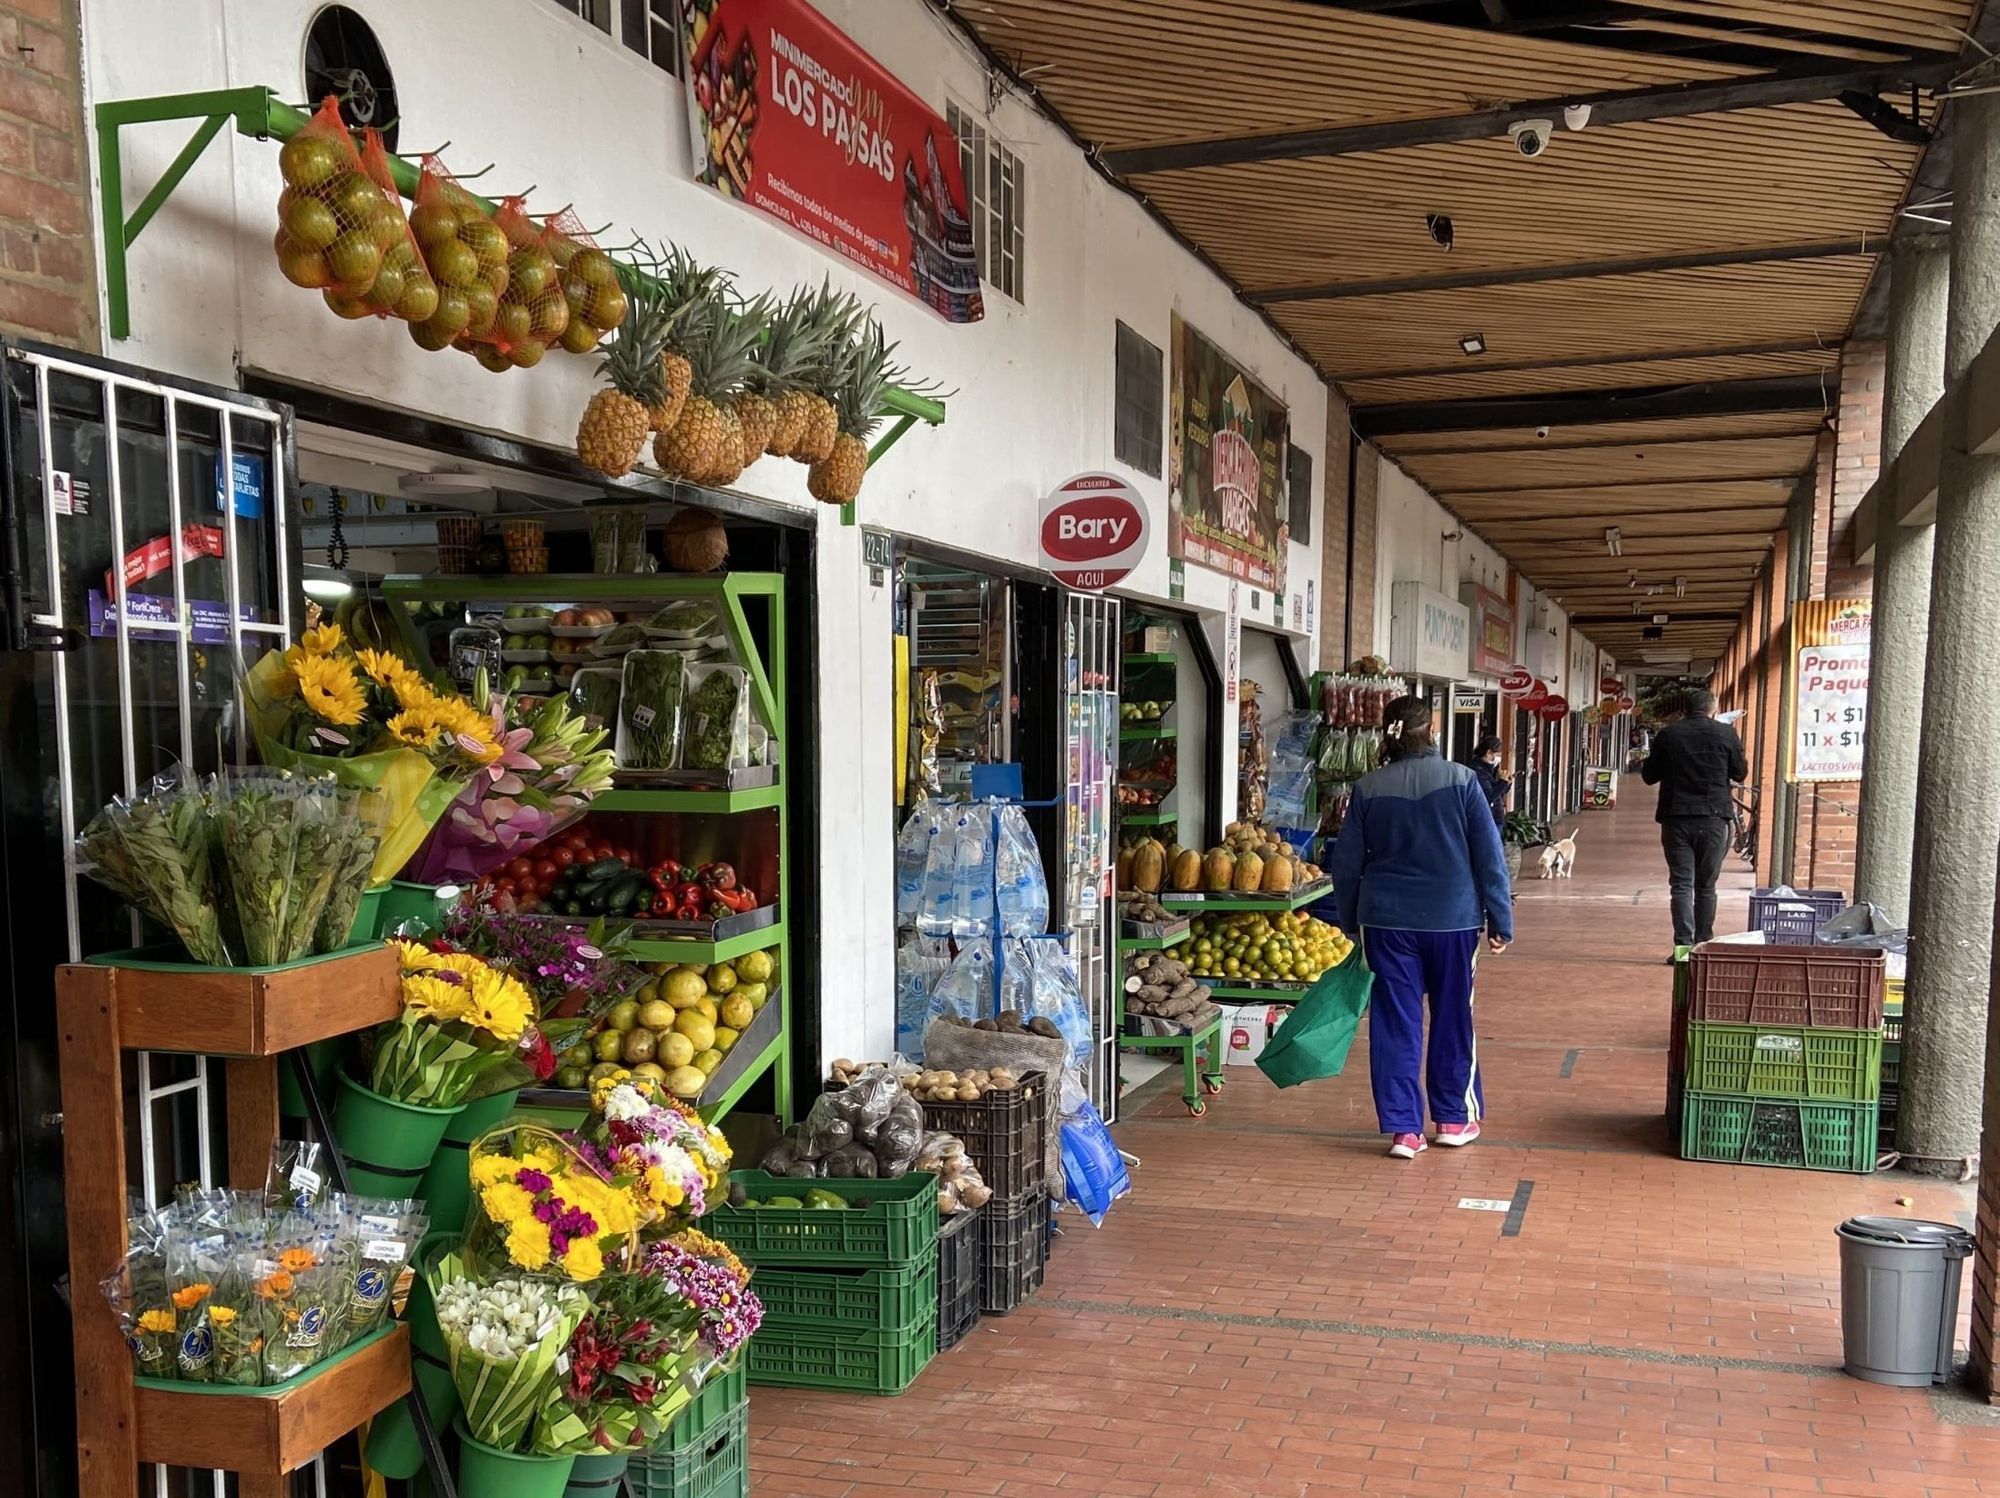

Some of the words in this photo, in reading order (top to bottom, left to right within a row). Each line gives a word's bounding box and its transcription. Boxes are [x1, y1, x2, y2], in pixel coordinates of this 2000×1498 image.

[771, 28, 854, 106] MINIMERCADO
[771, 54, 817, 127] LOS
[822, 92, 895, 182] PAISAS
[755, 191, 791, 221] DOMICILIOS
[768, 172, 804, 206] Recibimos
[803, 195, 823, 219] todos
[823, 205, 833, 223] los
[855, 225, 864, 241] de
[863, 234, 879, 253] pago
[1222, 488, 1250, 538] VARGAS
[1059, 514, 1128, 544] Bary
[1077, 570, 1105, 586] AQUÍ
[1830, 619, 1860, 634] MERCA
[1459, 698, 1481, 707] VISA
[1814, 708, 1820, 723] 1
[1803, 732, 1816, 747] 11
